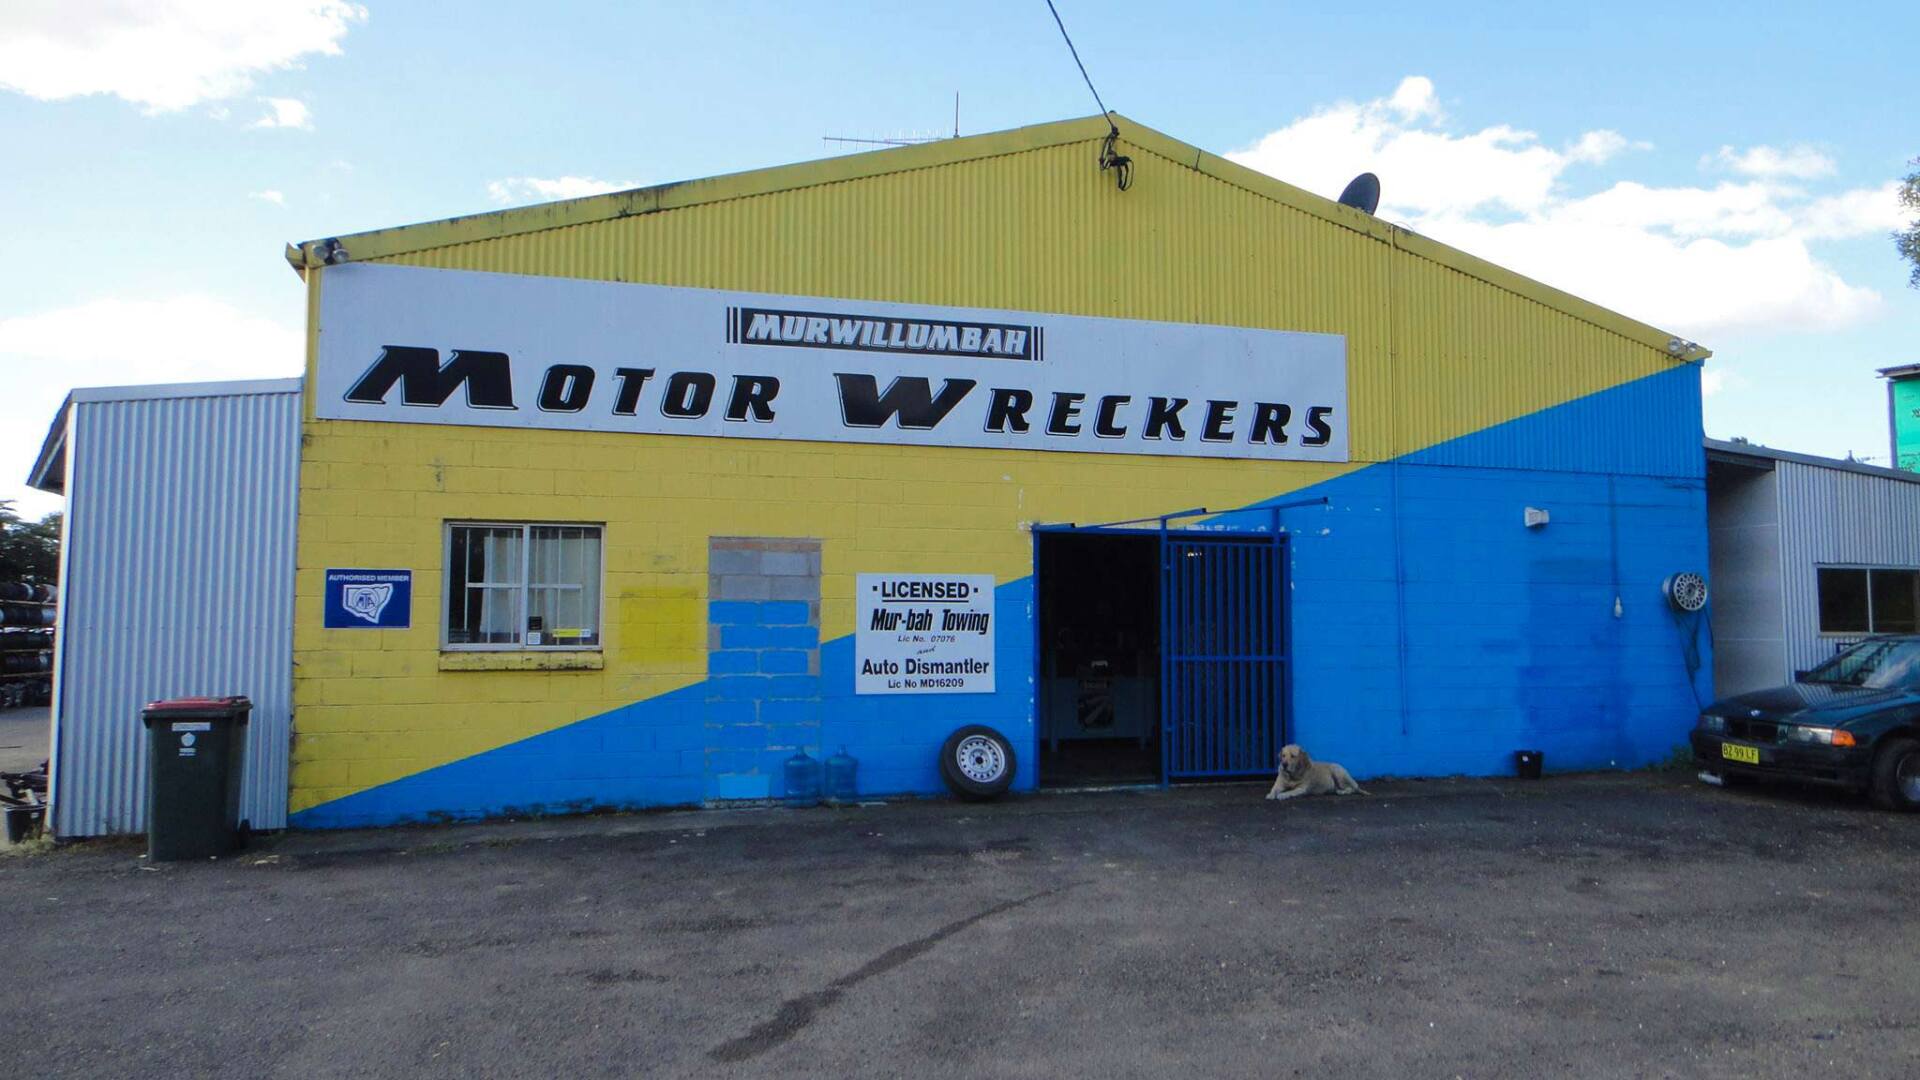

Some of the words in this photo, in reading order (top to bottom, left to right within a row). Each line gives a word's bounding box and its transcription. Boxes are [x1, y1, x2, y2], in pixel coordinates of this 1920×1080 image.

[746, 313, 1027, 355] MURWILLUMBAH
[343, 345, 781, 423] MOTOR
[833, 373, 1332, 447] WRECKERS
[881, 581, 969, 598] LICENSED
[871, 608, 933, 631] Mur-bah
[942, 609, 989, 635] Towing
[862, 659, 899, 675] Auto
[905, 658, 989, 674] Dismantler
[888, 680, 901, 688] Lic
[905, 680, 917, 688] No
[920, 678, 964, 688] MD16209
